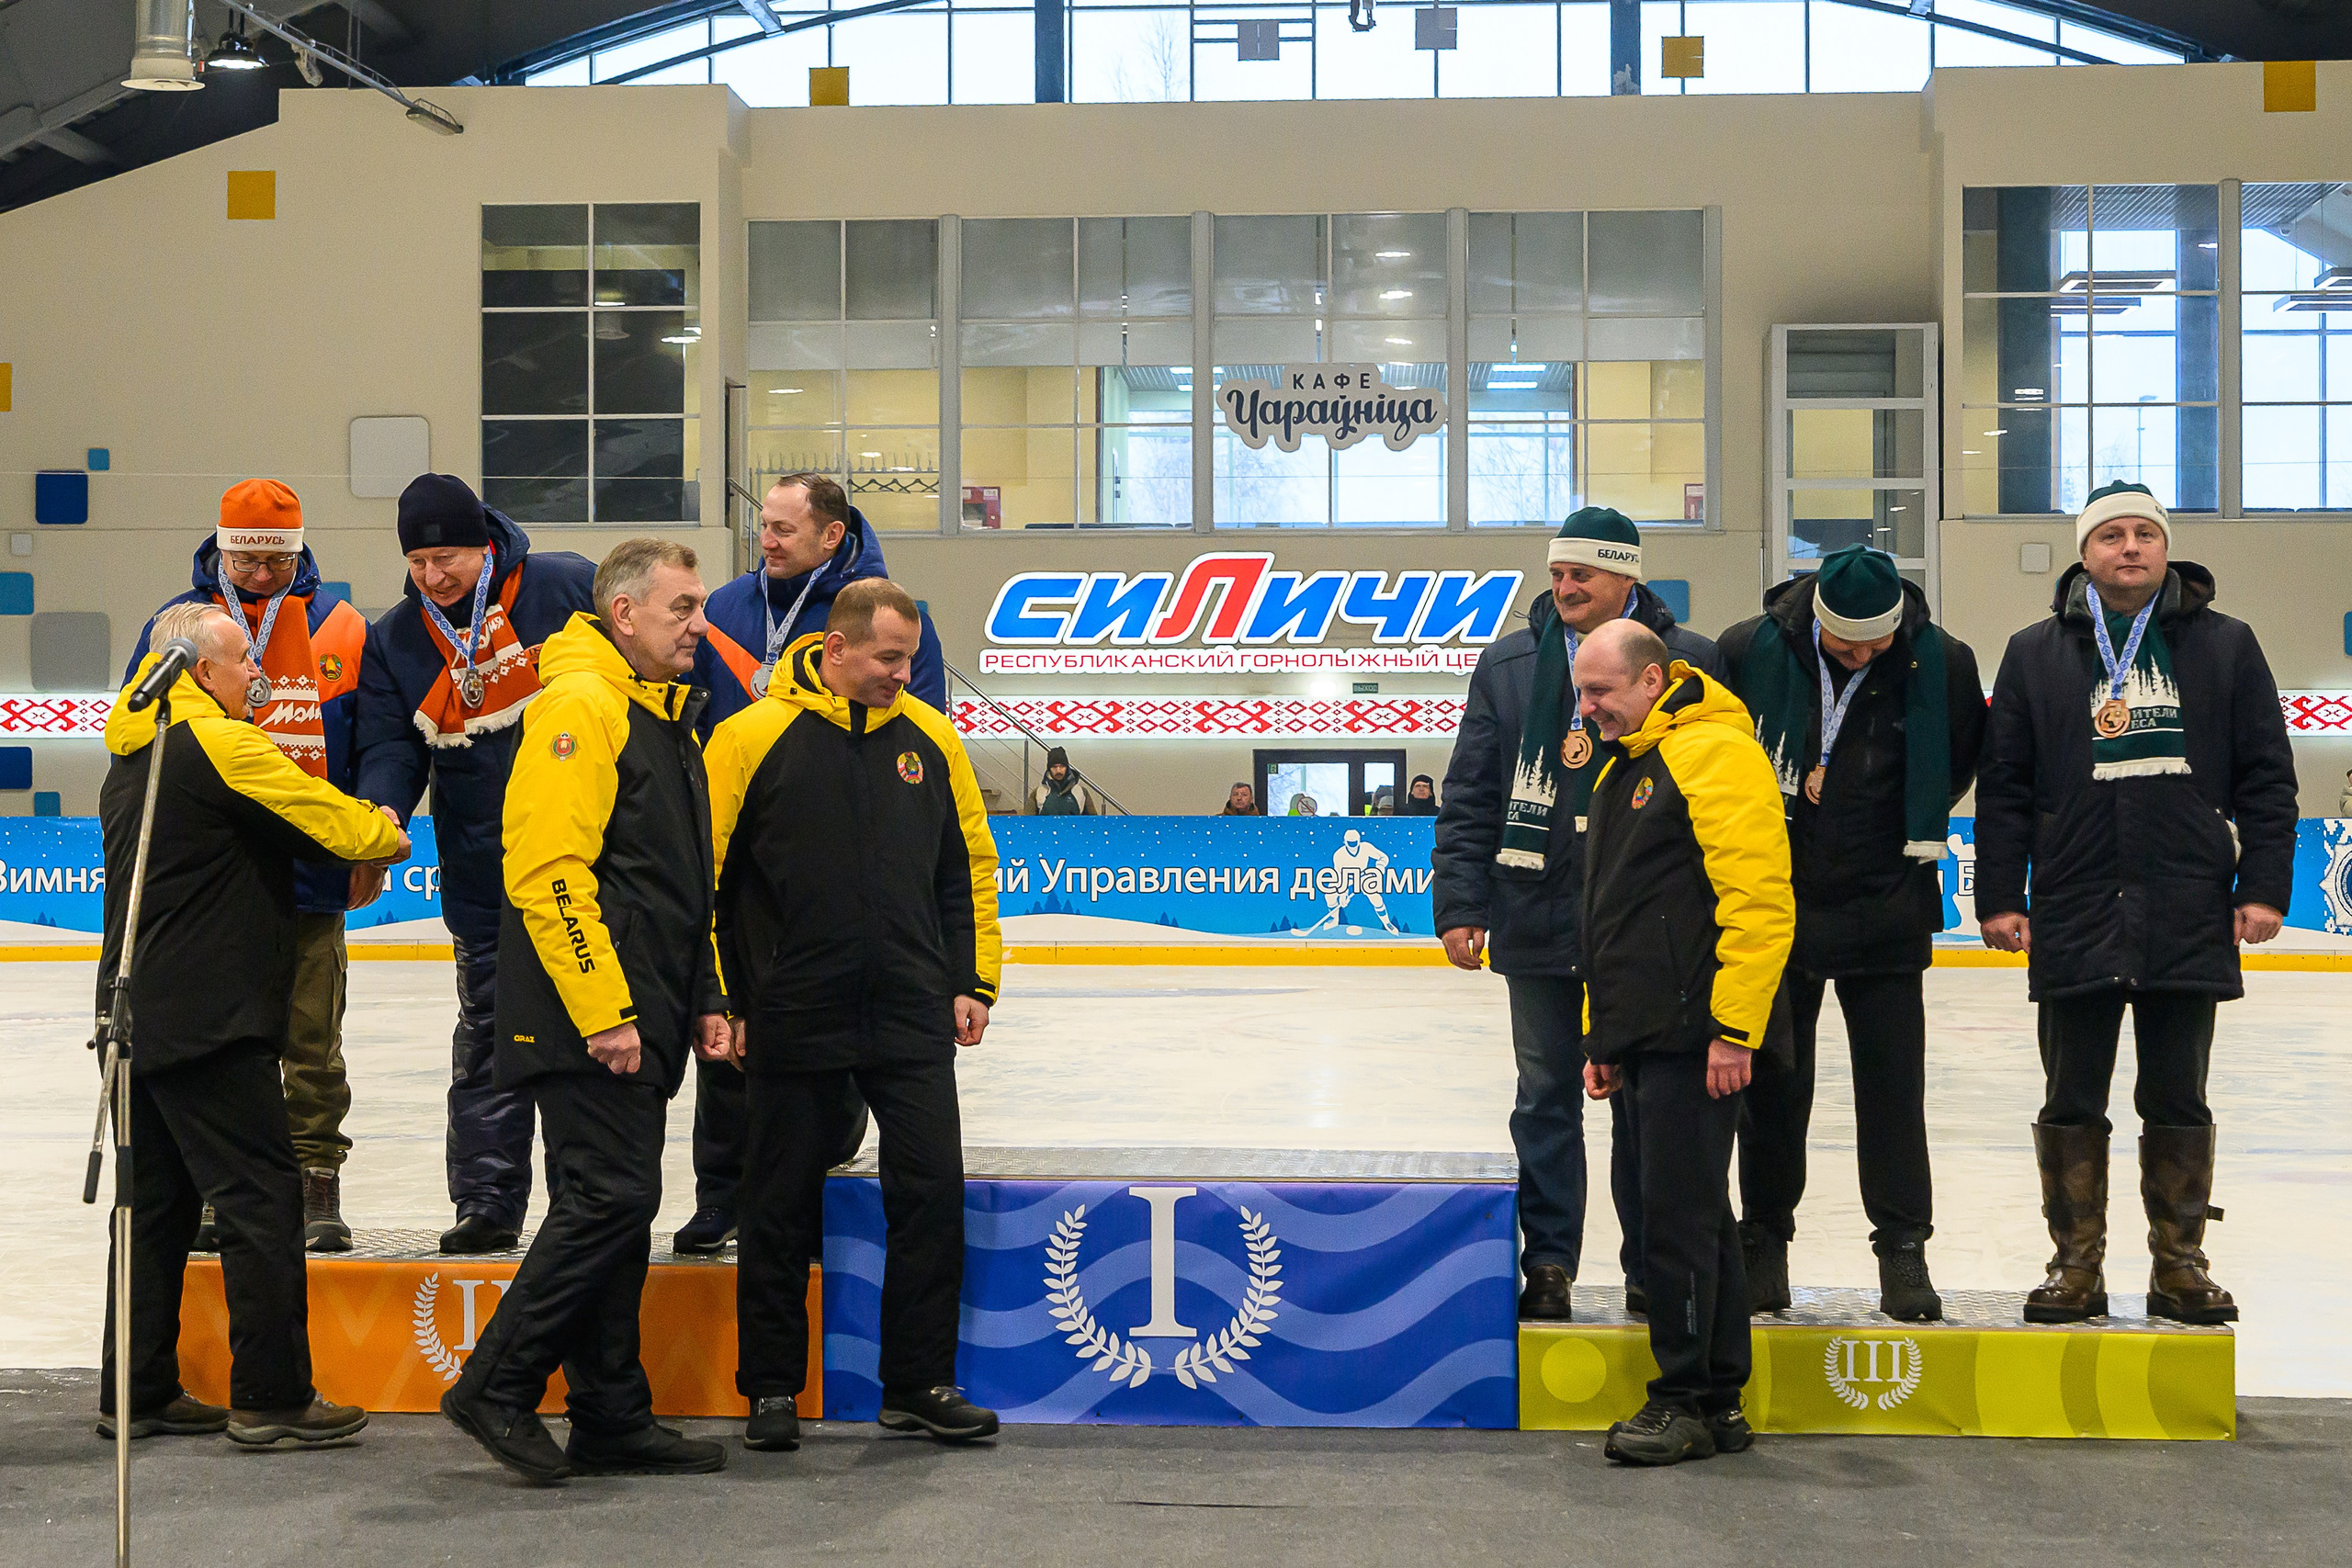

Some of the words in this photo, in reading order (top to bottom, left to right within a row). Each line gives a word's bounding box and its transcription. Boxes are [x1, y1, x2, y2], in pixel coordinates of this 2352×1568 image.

[1293, 373, 1371, 389] КАФЕ
[1227, 389, 1438, 442] Чараўніца
[230, 535, 286, 545] БЕЛАРУСЬ
[985, 650, 1233, 669] РЕСПУБЛИКАНСКИЙ
[1240, 649, 1439, 668] ГОРНОЛЫЖНЫЙ
[1446, 653, 1483, 670] ЦЕ
[2132, 707, 2177, 718] ИТЕЛИ
[2132, 718, 2157, 728] ЕСА
[1039, 858, 1280, 902] Управления
[1289, 866, 1435, 900] делами
[551, 878, 595, 974] BELARUS
[1128, 1186, 1197, 1337] I
[453, 1280, 514, 1350] I
[1840, 1340, 1906, 1382] III
